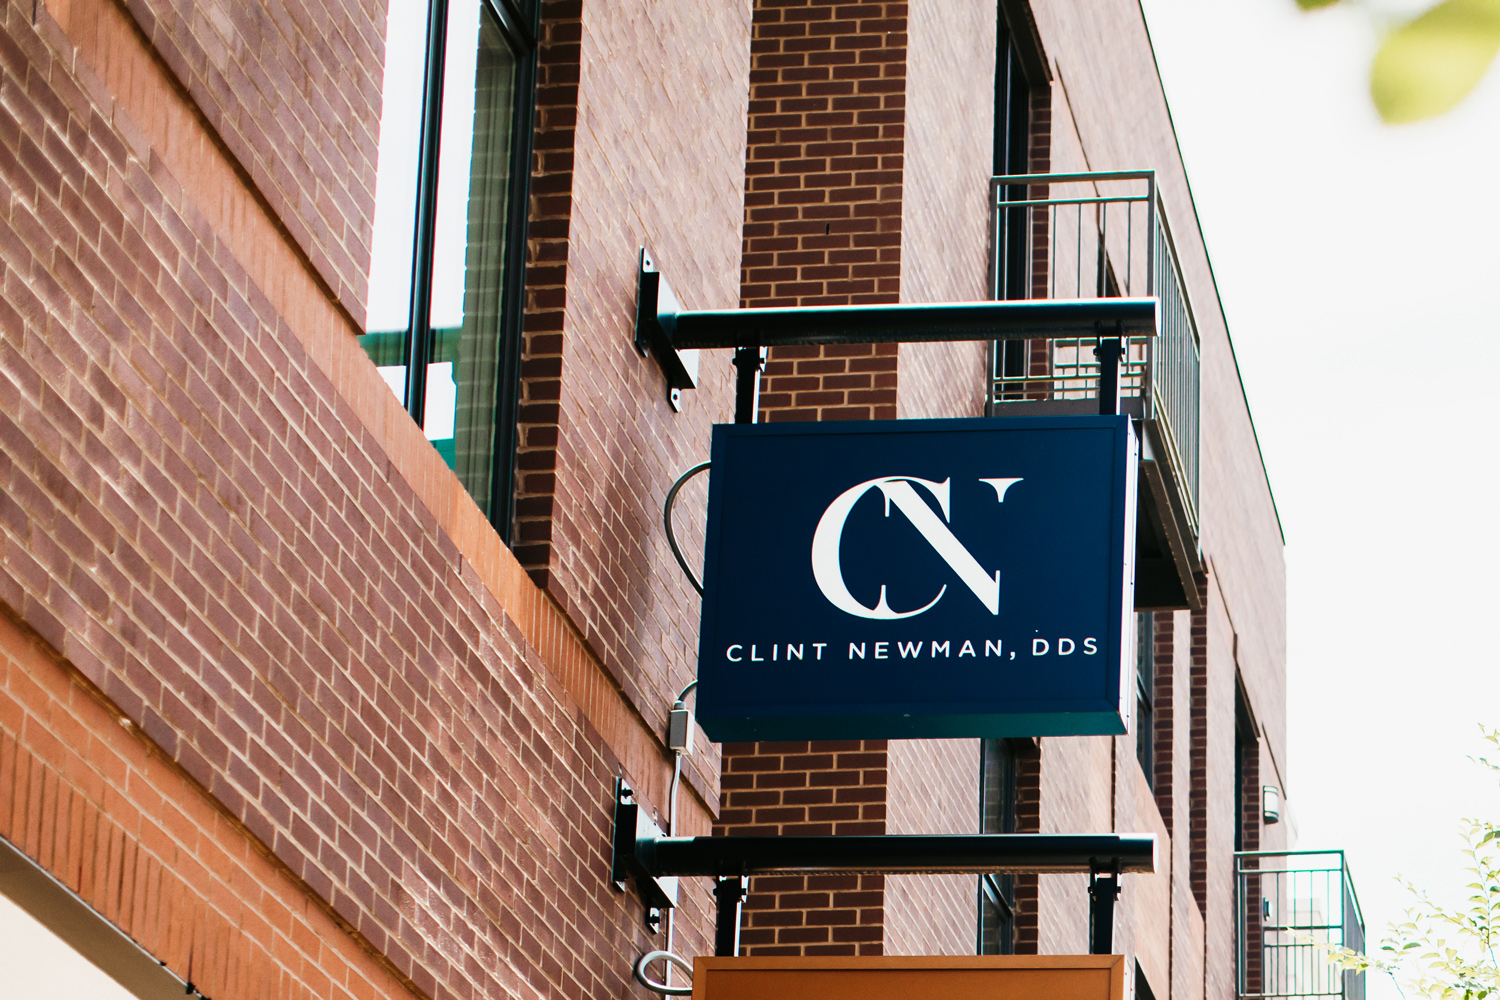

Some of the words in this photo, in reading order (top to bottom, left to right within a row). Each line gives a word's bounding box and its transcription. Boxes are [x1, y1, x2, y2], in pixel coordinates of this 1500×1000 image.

[726, 642, 827, 662] CLINT
[848, 639, 1016, 660] NEWMAN,
[1032, 637, 1098, 656] DDS
